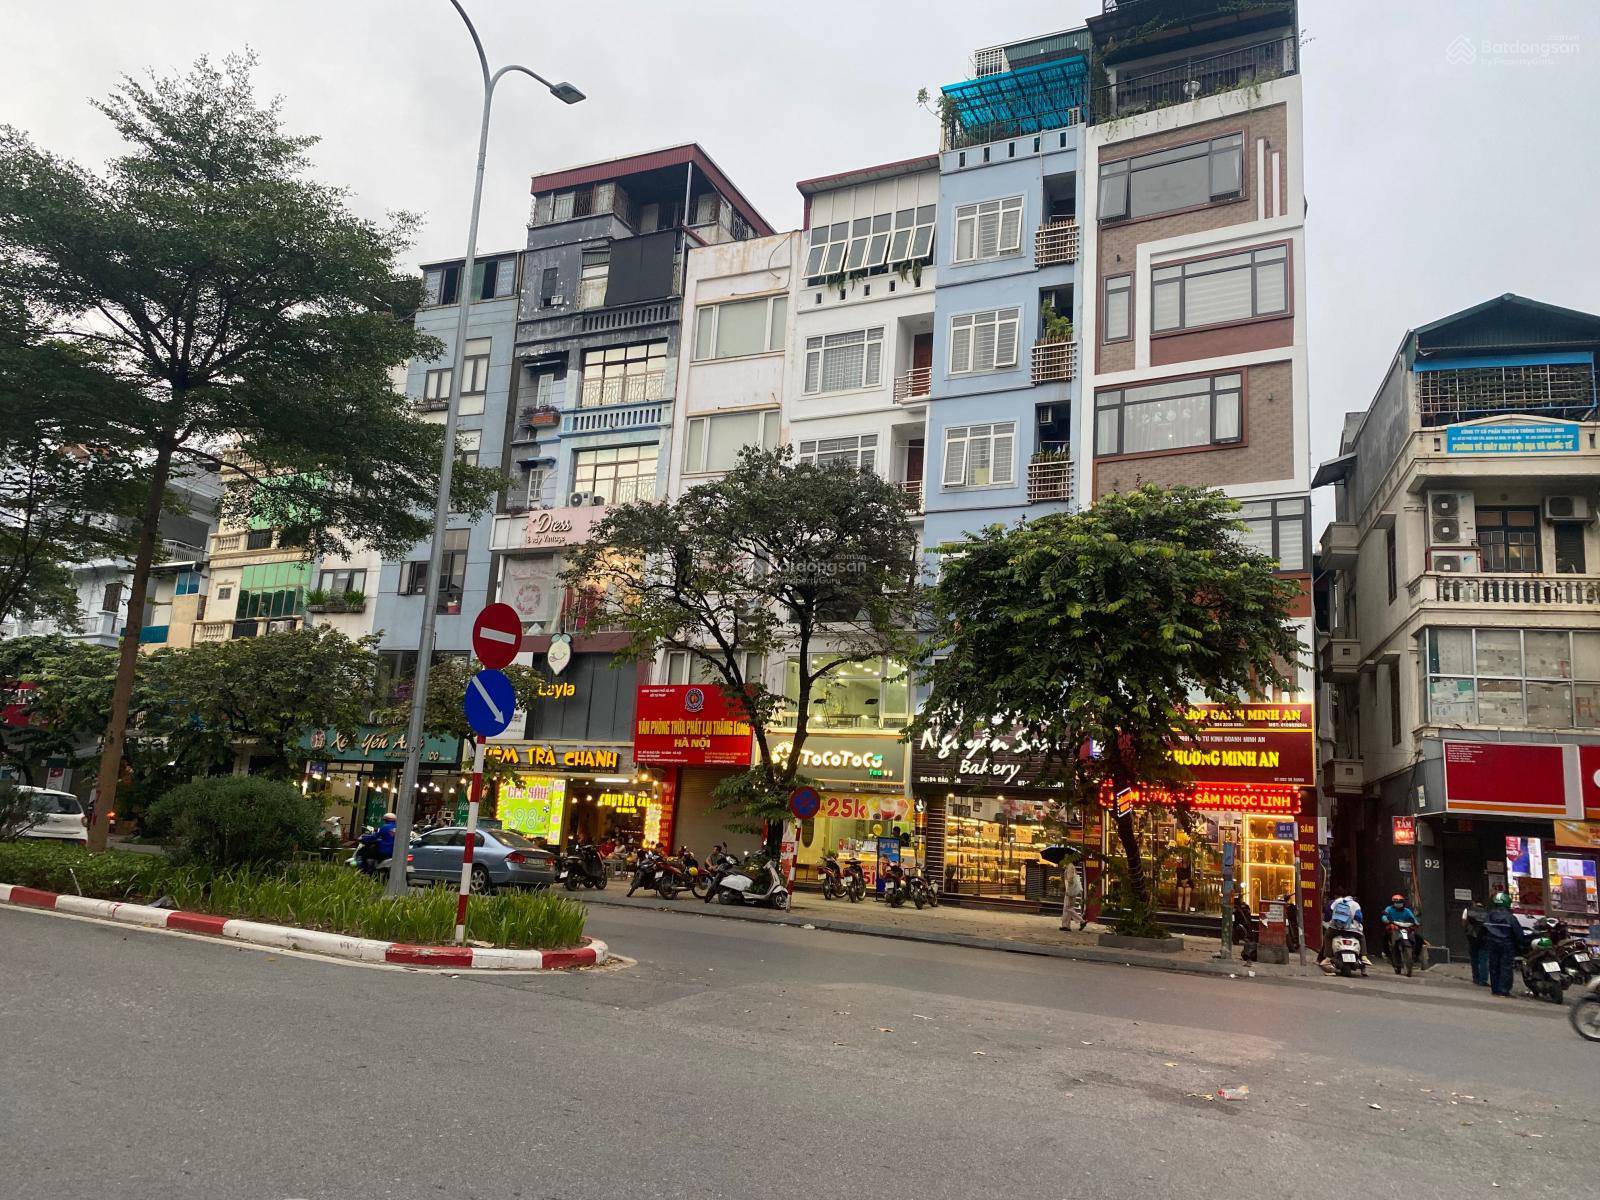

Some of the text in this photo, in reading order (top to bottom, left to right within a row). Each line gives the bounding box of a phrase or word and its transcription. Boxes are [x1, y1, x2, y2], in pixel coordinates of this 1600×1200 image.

[1247, 709, 1280, 721] MINH
[1282, 709, 1301, 721] AN
[525, 744, 557, 766] TRÀ
[564, 750, 618, 768] CHANH
[1221, 749, 1257, 767] MINH
[1258, 750, 1280, 768] AN
[960, 760, 1020, 784] Bakery
[827, 797, 866, 819] 25k
[1195, 793, 1220, 806] SÂM
[1223, 795, 1257, 808] NGỌC
[1260, 796, 1291, 808] LINH
[1424, 858, 1440, 869] 92
